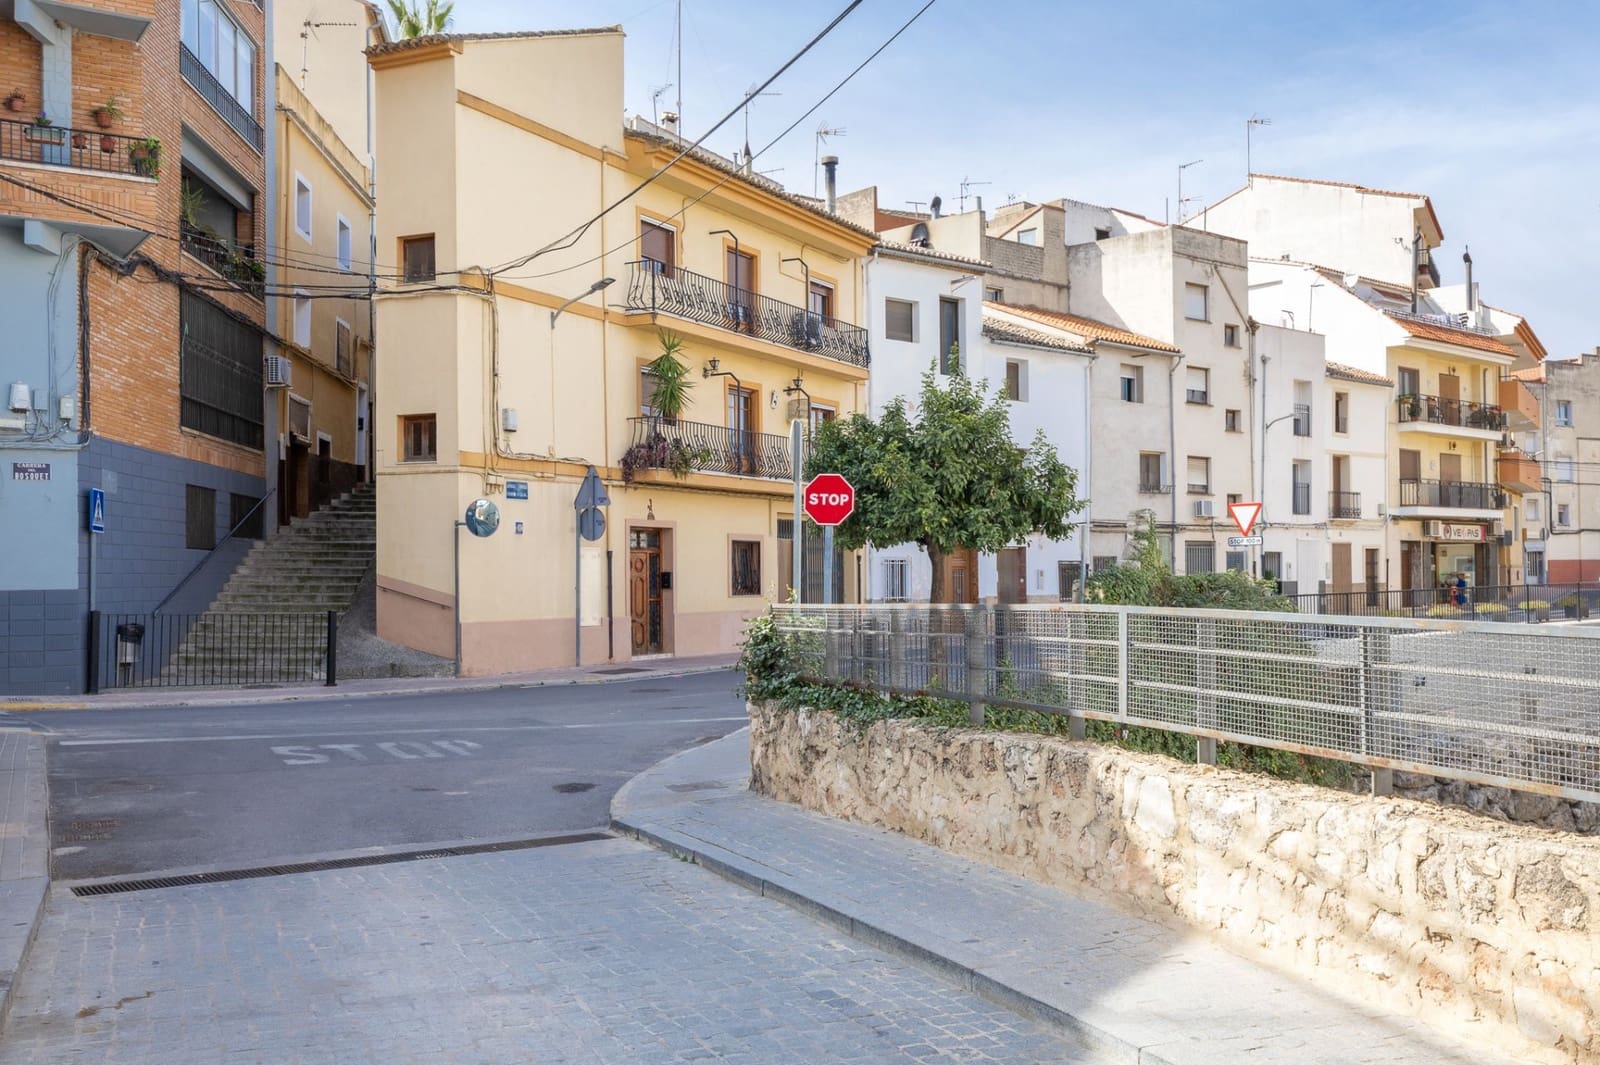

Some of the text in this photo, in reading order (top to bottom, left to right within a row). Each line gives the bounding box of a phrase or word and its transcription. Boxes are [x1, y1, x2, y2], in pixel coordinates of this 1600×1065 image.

[15, 472, 49, 480] BOSQUET
[809, 493, 850, 506] STOP
[270, 740, 482, 765] STOP
